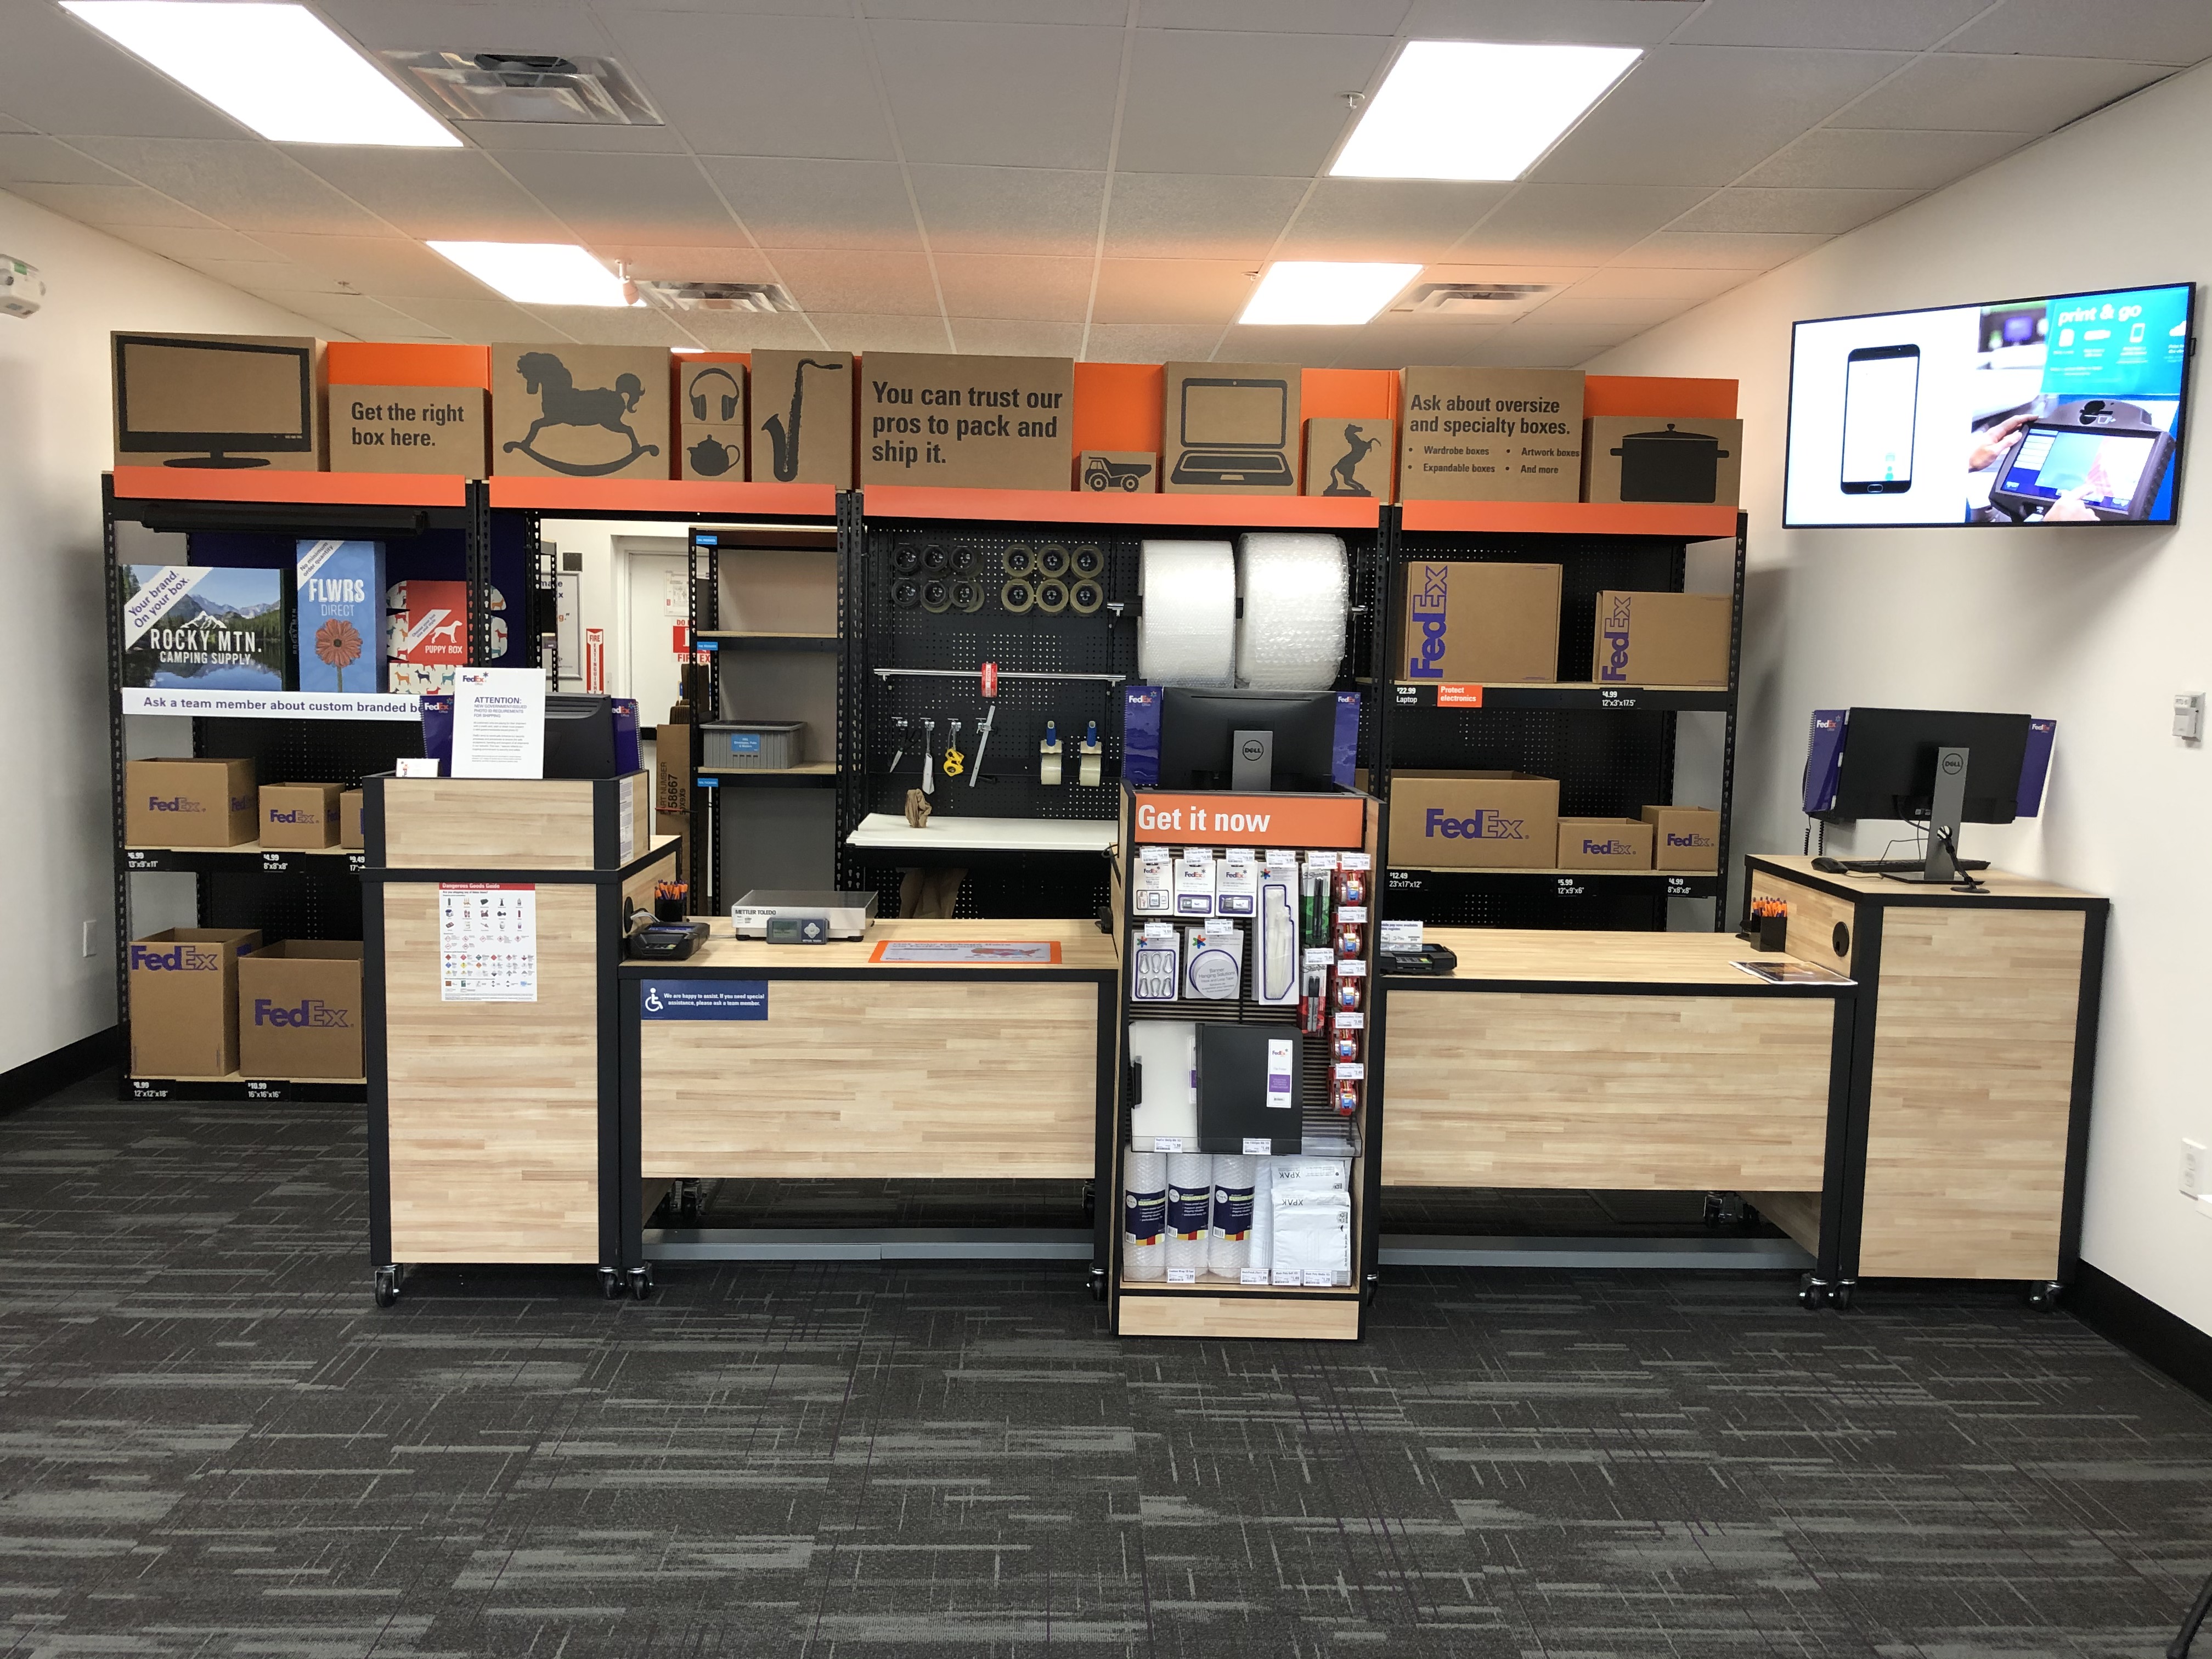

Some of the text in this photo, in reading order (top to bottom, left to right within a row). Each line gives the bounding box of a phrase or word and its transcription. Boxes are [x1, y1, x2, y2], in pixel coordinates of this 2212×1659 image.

[2058, 303, 2142, 326] print & go
[872, 381, 1063, 409] You can trust our
[1411, 395, 1560, 414] Ask about oversize
[352, 402, 464, 426] Get the right
[352, 427, 435, 447] box here.
[873, 415, 1057, 441] pros to pack and
[1410, 416, 1570, 437] and specialty boxes.
[872, 441, 946, 468] ship it.
[1424, 447, 1489, 456] Wardrobe boxes
[1521, 448, 1580, 458] Artwork boxes
[1424, 464, 1495, 475] Expandable boxes
[1521, 465, 1558, 475] And more
[300, 541, 328, 571] No minimum
[303, 545, 334, 577] order quantity
[128, 571, 179, 617] Your brand.
[309, 579, 365, 602] FLWRS
[134, 577, 190, 628] On your box.
[321, 604, 354, 616] DIRECT
[1410, 566, 1447, 678] FedEx
[150, 629, 262, 652] ROCKY MTN.
[1602, 596, 1630, 681] FedEx
[160, 651, 251, 665] CAMPING SUPPLY
[448, 646, 462, 654] BOX
[144, 697, 166, 707] Ask
[181, 699, 211, 708] team
[216, 700, 266, 709] member
[270, 701, 305, 710] about
[309, 702, 352, 711] custom
[357, 702, 406, 712] branded
[1128, 695, 1152, 703] FedEx
[1397, 696, 1417, 704] Laptop
[1441, 694, 1476, 702] electronics
[149, 796, 201, 812] FedEx
[270, 809, 315, 823] FedEx
[1138, 804, 1271, 832] Get it now
[1425, 809, 1523, 839] FedEx
[1583, 839, 1631, 855] FedEx
[1667, 833, 1710, 847] FedEx
[132, 946, 218, 972] FedEx
[255, 1000, 349, 1029] FedEx
